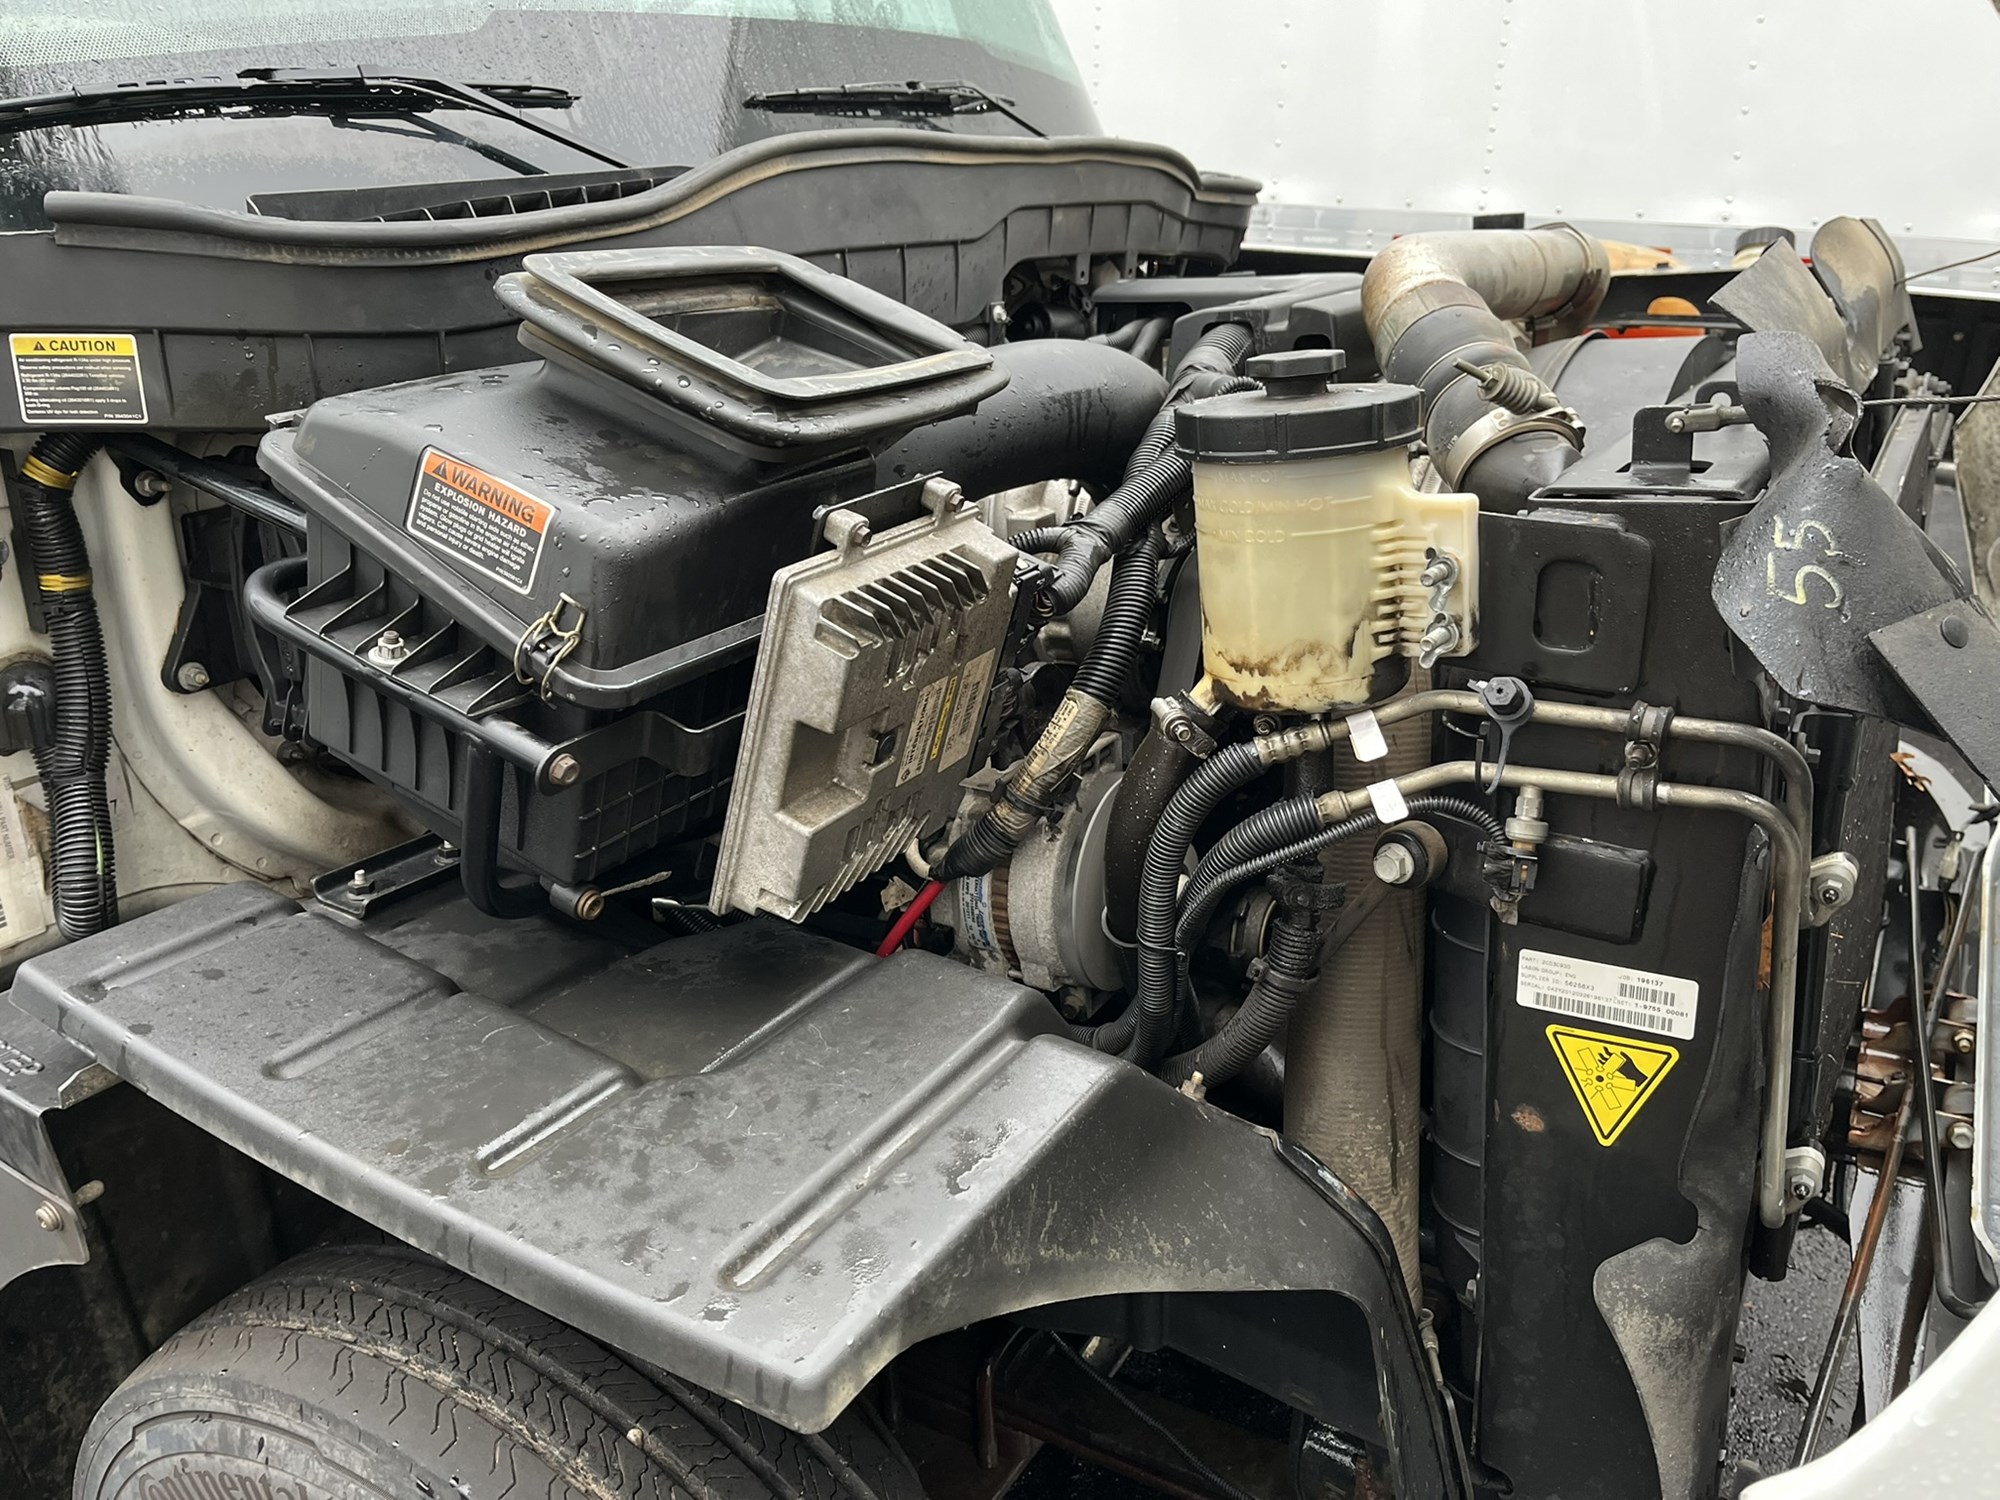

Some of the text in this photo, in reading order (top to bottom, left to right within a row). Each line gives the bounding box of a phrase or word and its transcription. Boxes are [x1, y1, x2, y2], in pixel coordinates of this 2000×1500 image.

[49, 340, 116, 352] CAUTION
[450, 466, 536, 524] WARNING
[1217, 470, 1279, 482] MAX HOT
[422, 488, 536, 554] Do not use volatile starting aids such as ether,
[433, 482, 527, 538] EXPLOSION HAZARD
[1198, 498, 1216, 510] MAX
[1297, 496, 1333, 511] HOT
[416, 517, 426, 527] and
[425, 523, 447, 540] personal
[447, 534, 462, 548] injury
[468, 546, 485, 560] death.
[417, 510, 521, 572] vapors. Can cause severe engine damage
[419, 503, 438, 519] system.
[438, 513, 452, 525] Glow
[452, 520, 467, 534] plugs
[472, 532, 483, 543] grid
[483, 538, 500, 551] heater
[500, 546, 510, 556] will
[509, 552, 525, 565] ignite
[420, 496, 441, 512] propane
[447, 510, 469, 527] gasoline
[475, 525, 484, 534] the
[484, 530, 502, 545] engine
[509, 543, 526, 557] intake
[1219, 529, 1286, 543] MIN COLD
[1521, 973, 1554, 982] SUPPLIER
[1637, 977, 1664, 987] 196137
[1520, 980, 1545, 990] SERIAL:
[1634, 1002, 1661, 1013] 1-9755
[1666, 1008, 1689, 1018] 00081
